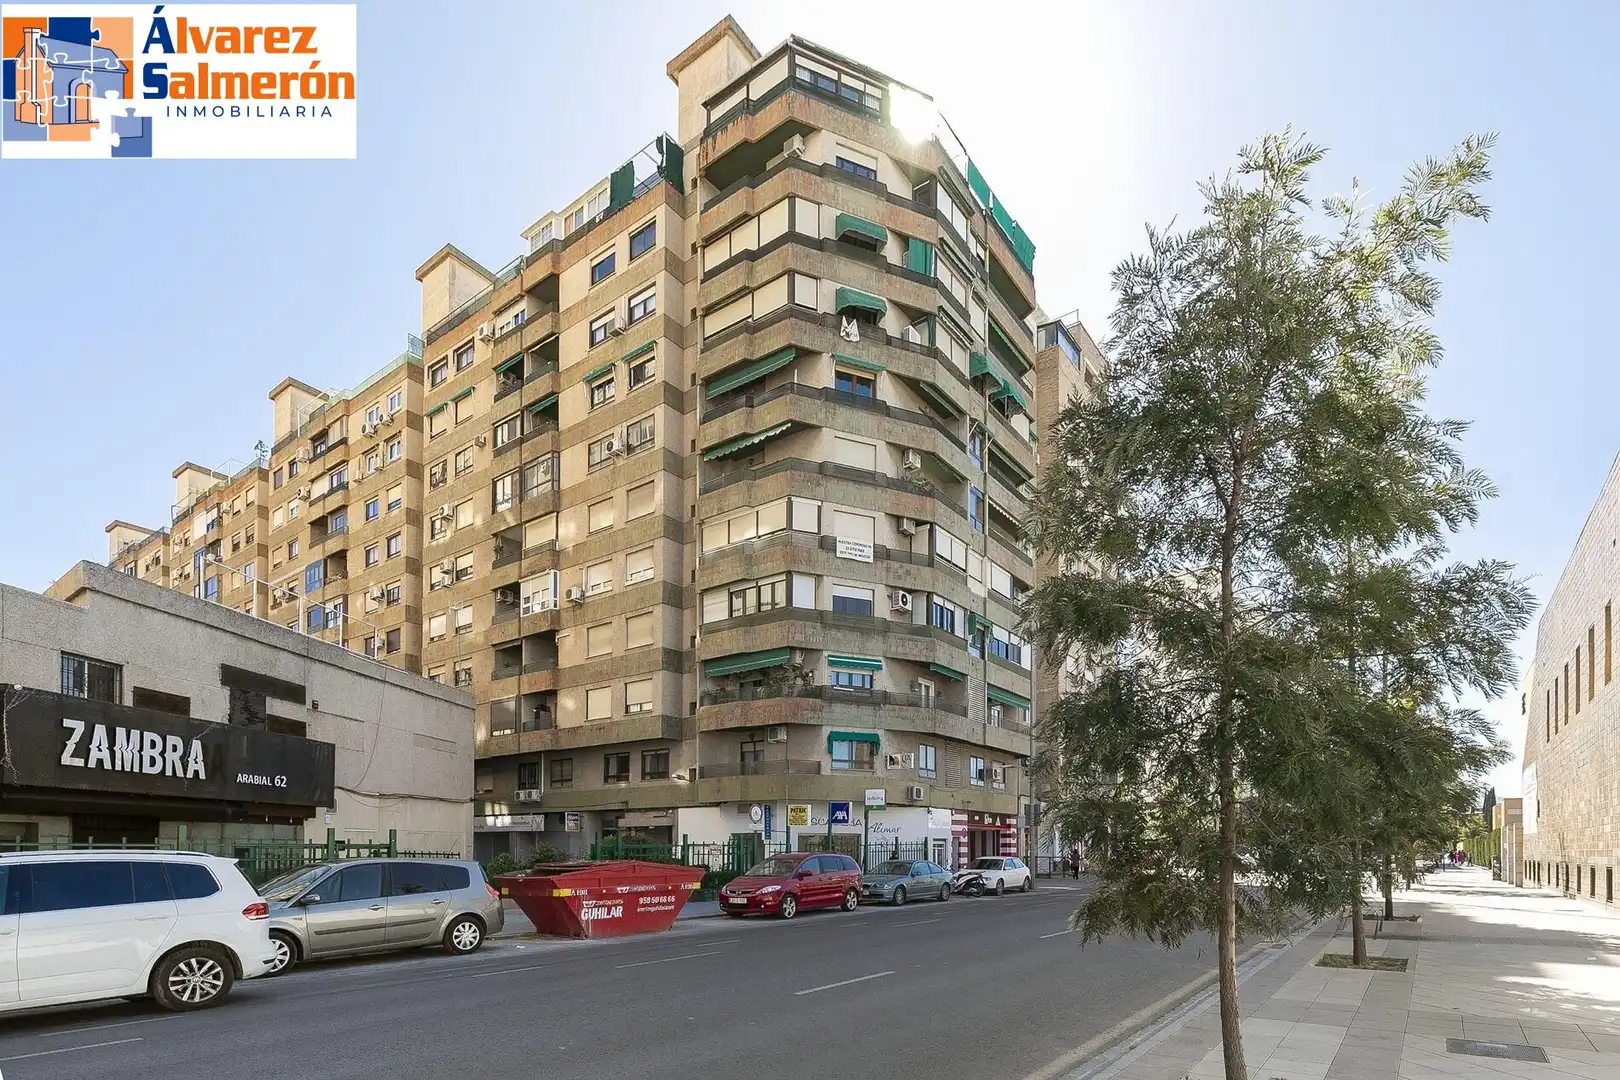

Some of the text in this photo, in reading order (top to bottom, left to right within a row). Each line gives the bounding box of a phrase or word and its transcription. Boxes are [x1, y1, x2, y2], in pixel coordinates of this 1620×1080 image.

[61, 718, 206, 780] ZAMBRA
[237, 773, 287, 787] ARABIAL 62
[832, 811, 848, 820] AXA
[581, 906, 623, 920] GUHILAR
